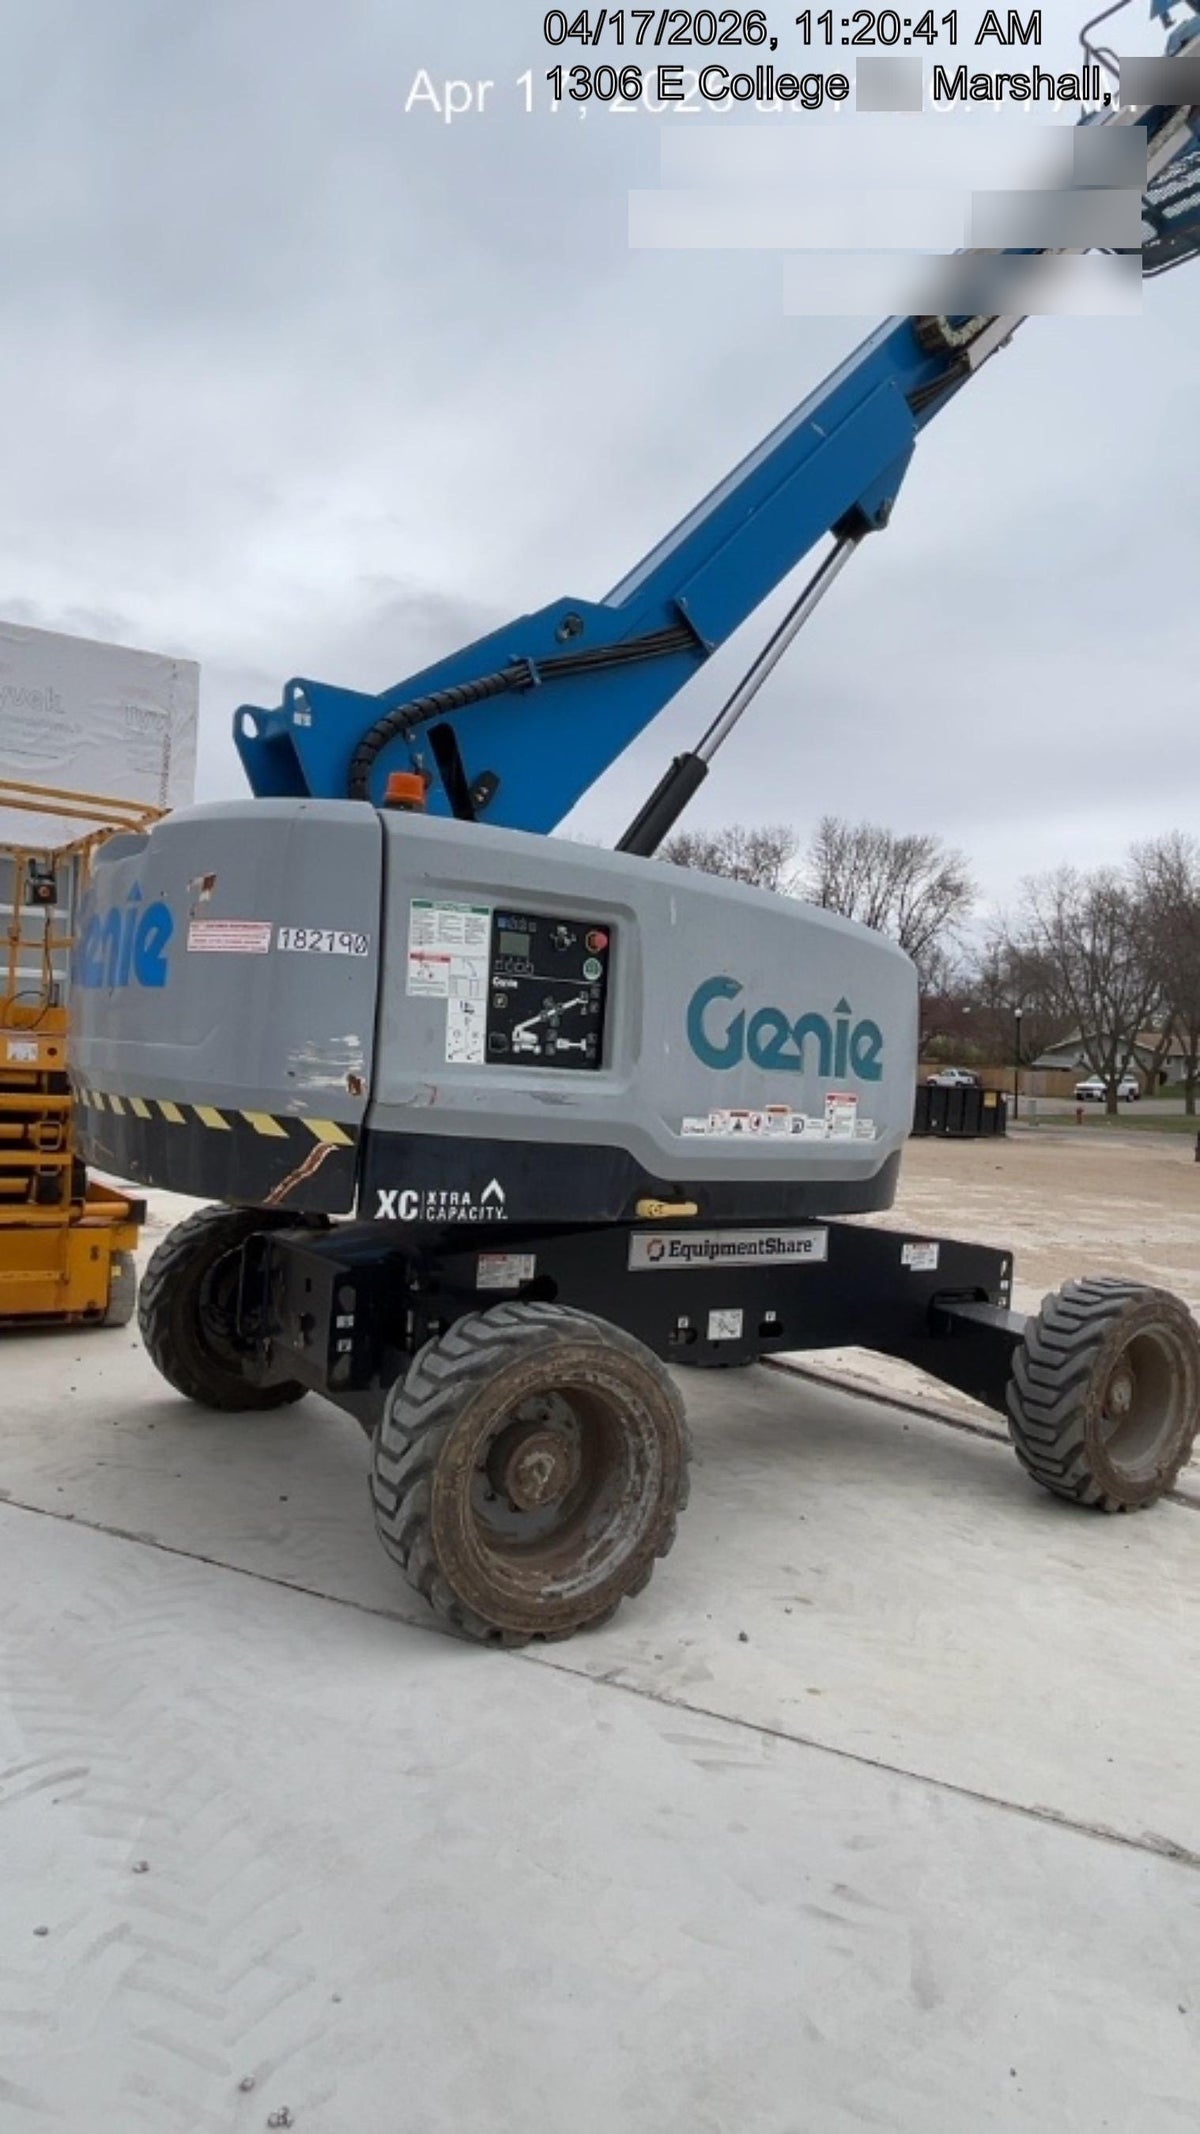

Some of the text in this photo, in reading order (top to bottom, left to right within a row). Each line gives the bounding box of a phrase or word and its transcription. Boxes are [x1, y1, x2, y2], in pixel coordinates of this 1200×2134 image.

[282, 928, 367, 954] 182190
[687, 975, 883, 1082] Genie
[374, 1189, 470, 1220] XC XTRA
[669, 1236, 816, 1262] EquipmentShare
